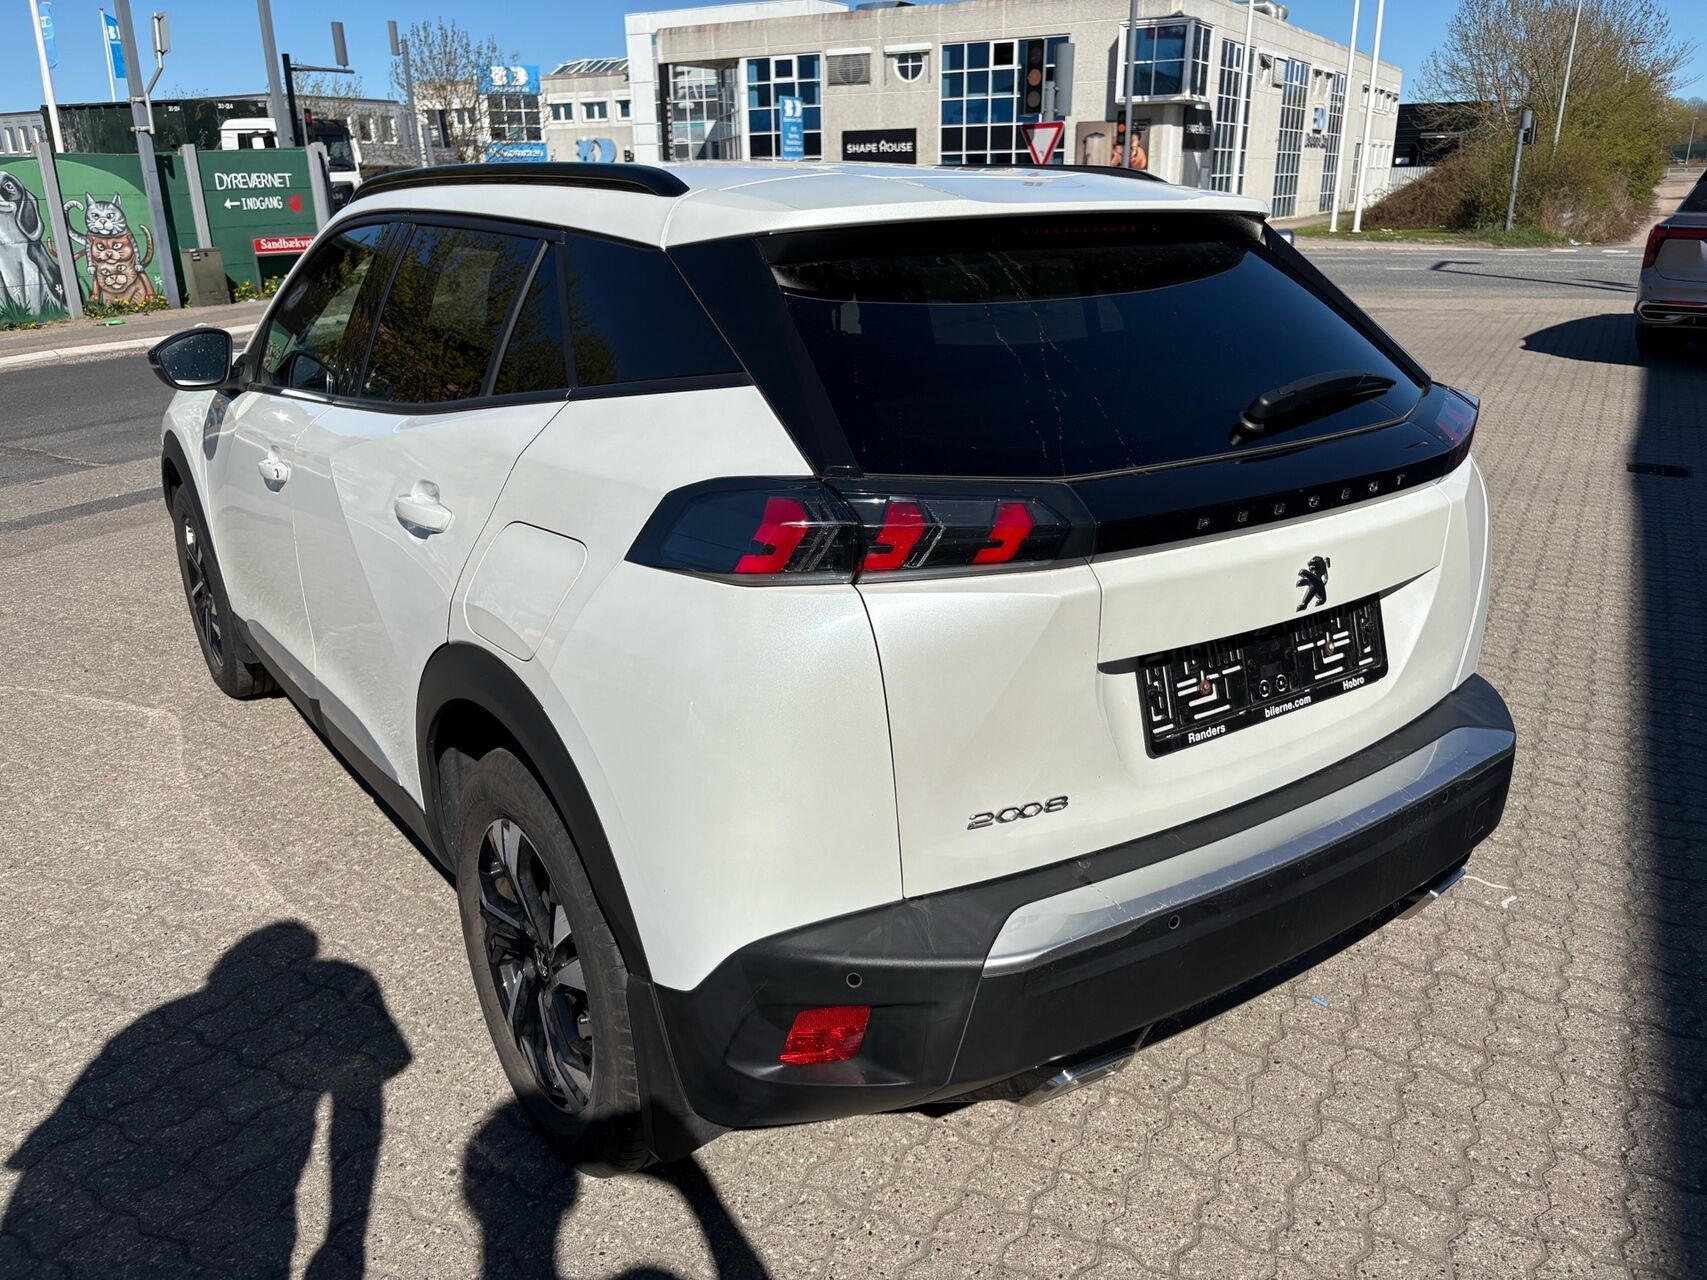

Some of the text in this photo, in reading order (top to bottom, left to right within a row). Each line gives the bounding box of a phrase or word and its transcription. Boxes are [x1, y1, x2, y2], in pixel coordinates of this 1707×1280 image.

[846, 139, 913, 153] SHAPE HOUSE
[214, 172, 292, 190] DYREVÆRNET
[241, 196, 283, 210] INDGANG
[1197, 473, 1405, 530] PEUGEOT
[1188, 676, 1365, 744] Randers bilerne.com Hobro
[967, 795, 1069, 830] 2008
